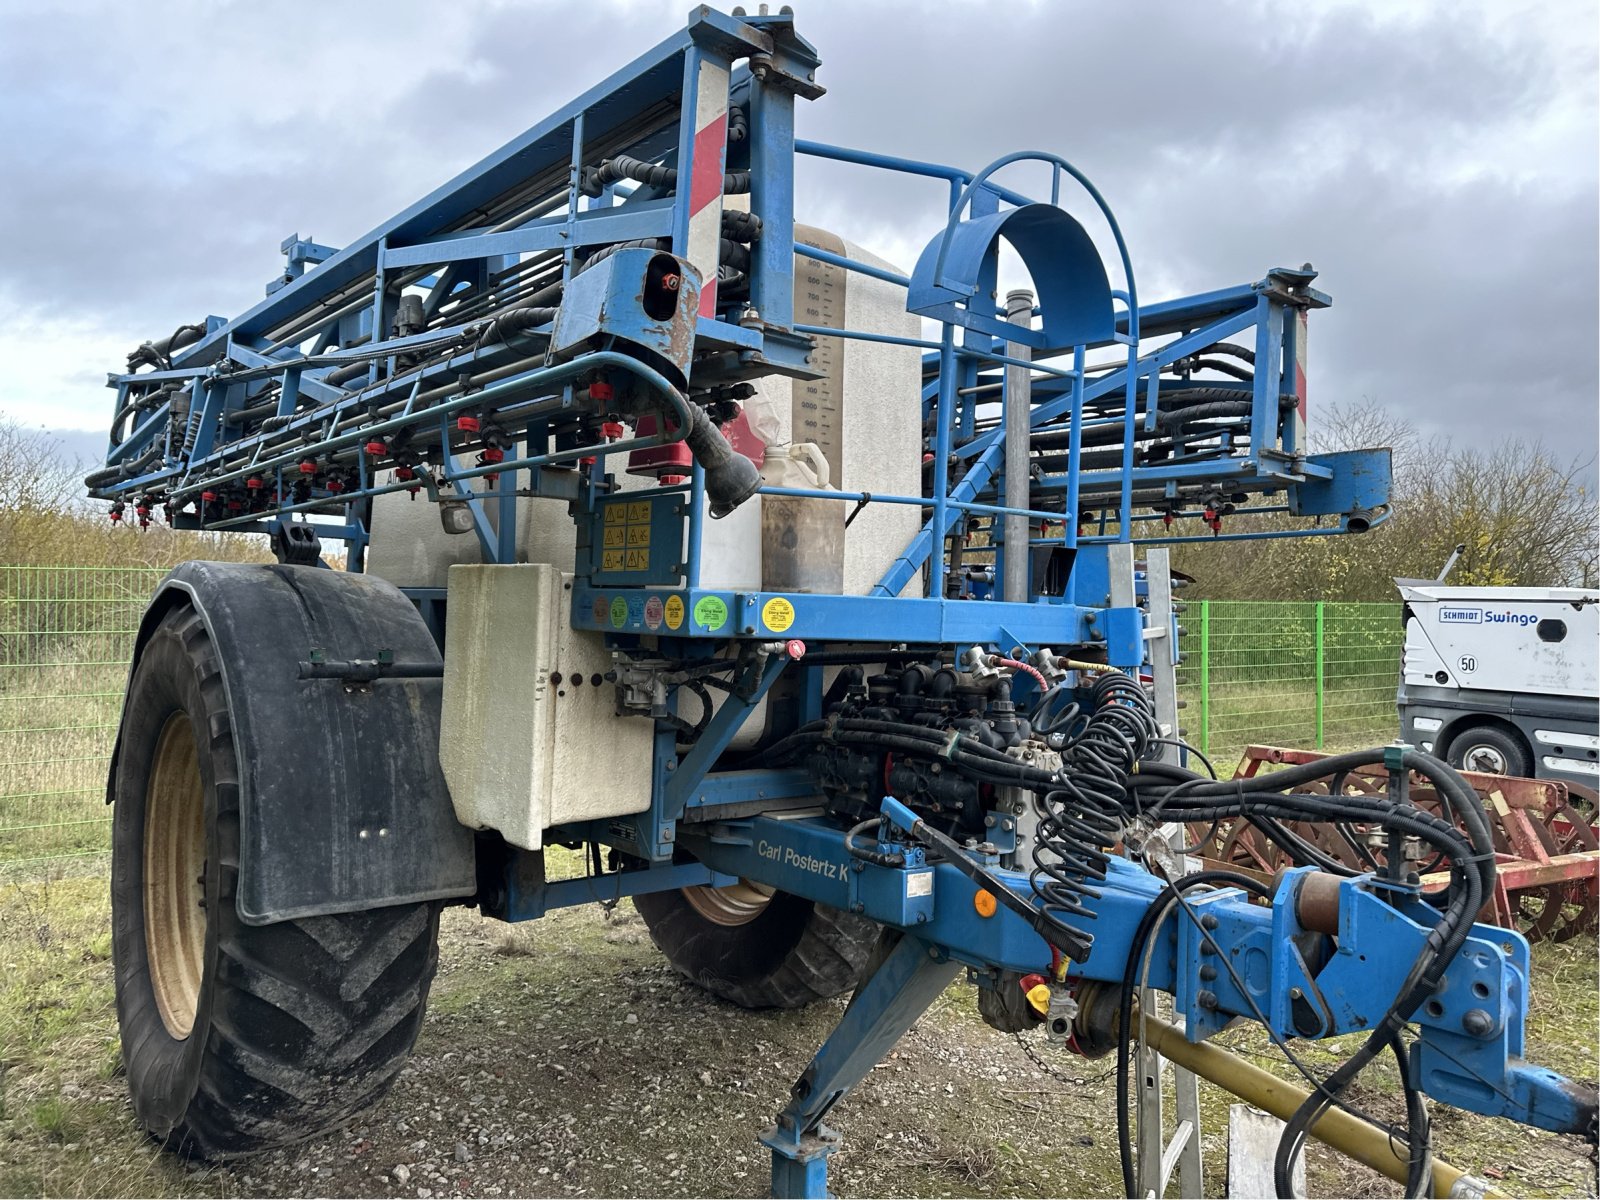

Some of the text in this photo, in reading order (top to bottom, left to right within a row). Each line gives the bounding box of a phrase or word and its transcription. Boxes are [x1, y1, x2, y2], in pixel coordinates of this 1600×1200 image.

[808, 292, 820, 301] 700
[1443, 610, 1538, 626] SCHMIDT Swingo
[1461, 658, 1475, 671] 50
[758, 840, 781, 861] Carl
[784, 848, 836, 878] Postertz
